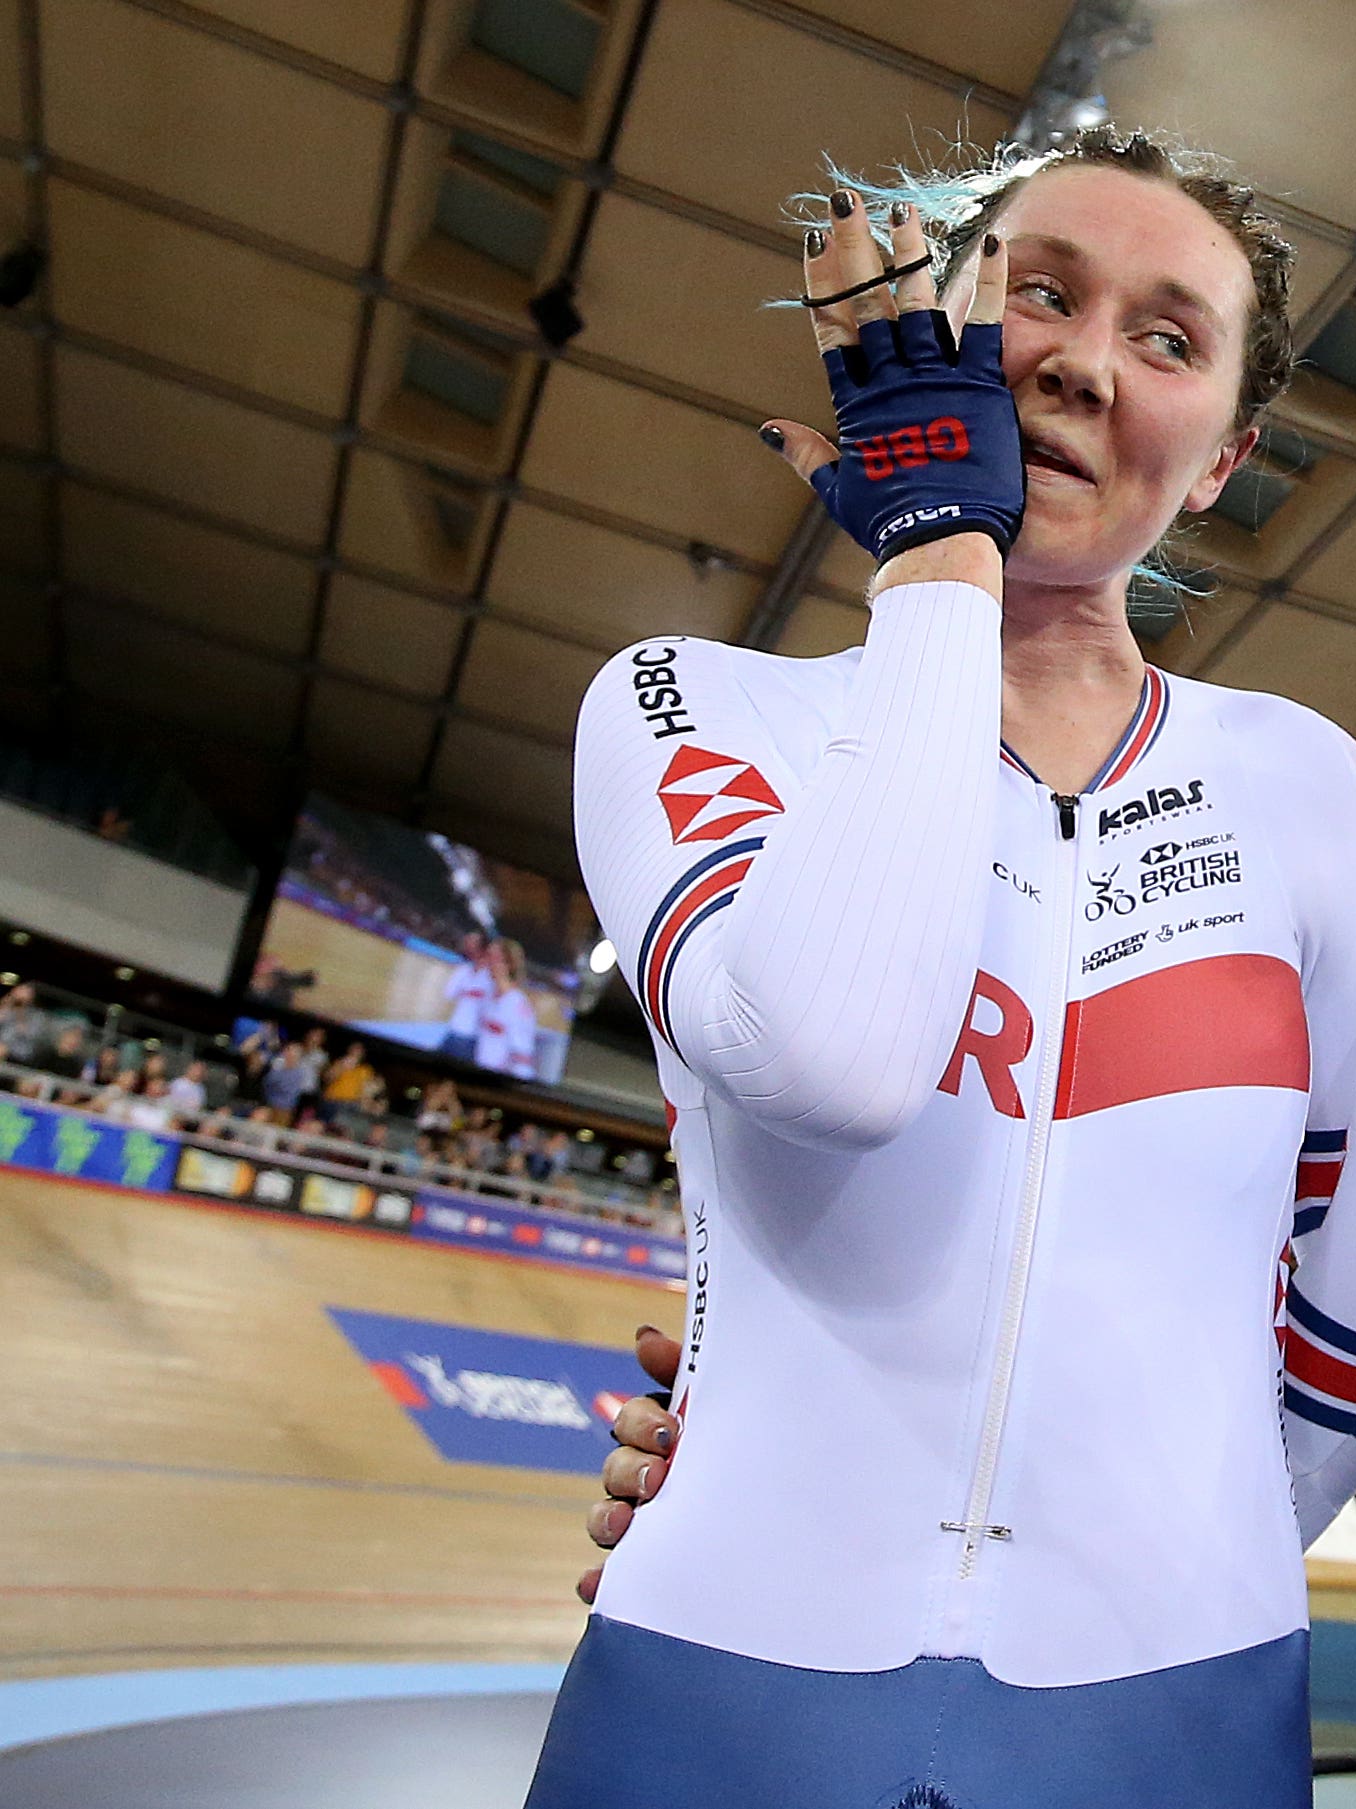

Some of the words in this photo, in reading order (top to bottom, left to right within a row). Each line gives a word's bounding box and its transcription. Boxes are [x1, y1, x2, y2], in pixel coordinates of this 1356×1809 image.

[854, 416, 969, 480] GBR
[632, 647, 697, 739] HSBC
[1099, 779, 1204, 837] kalas
[1186, 835, 1219, 850] HSBC
[1220, 832, 1236, 843] UK
[1013, 873, 1041, 903] UK
[1140, 850, 1240, 889] BRITISH
[1142, 868, 1241, 903] CYCLING
[1178, 919, 1199, 933] uk
[1203, 912, 1245, 928] sport
[1082, 930, 1149, 965] LOTTERY
[1082, 943, 1144, 975] FUNDED
[693, 1200, 709, 1255] UK
[687, 1261, 708, 1373] HSBC
